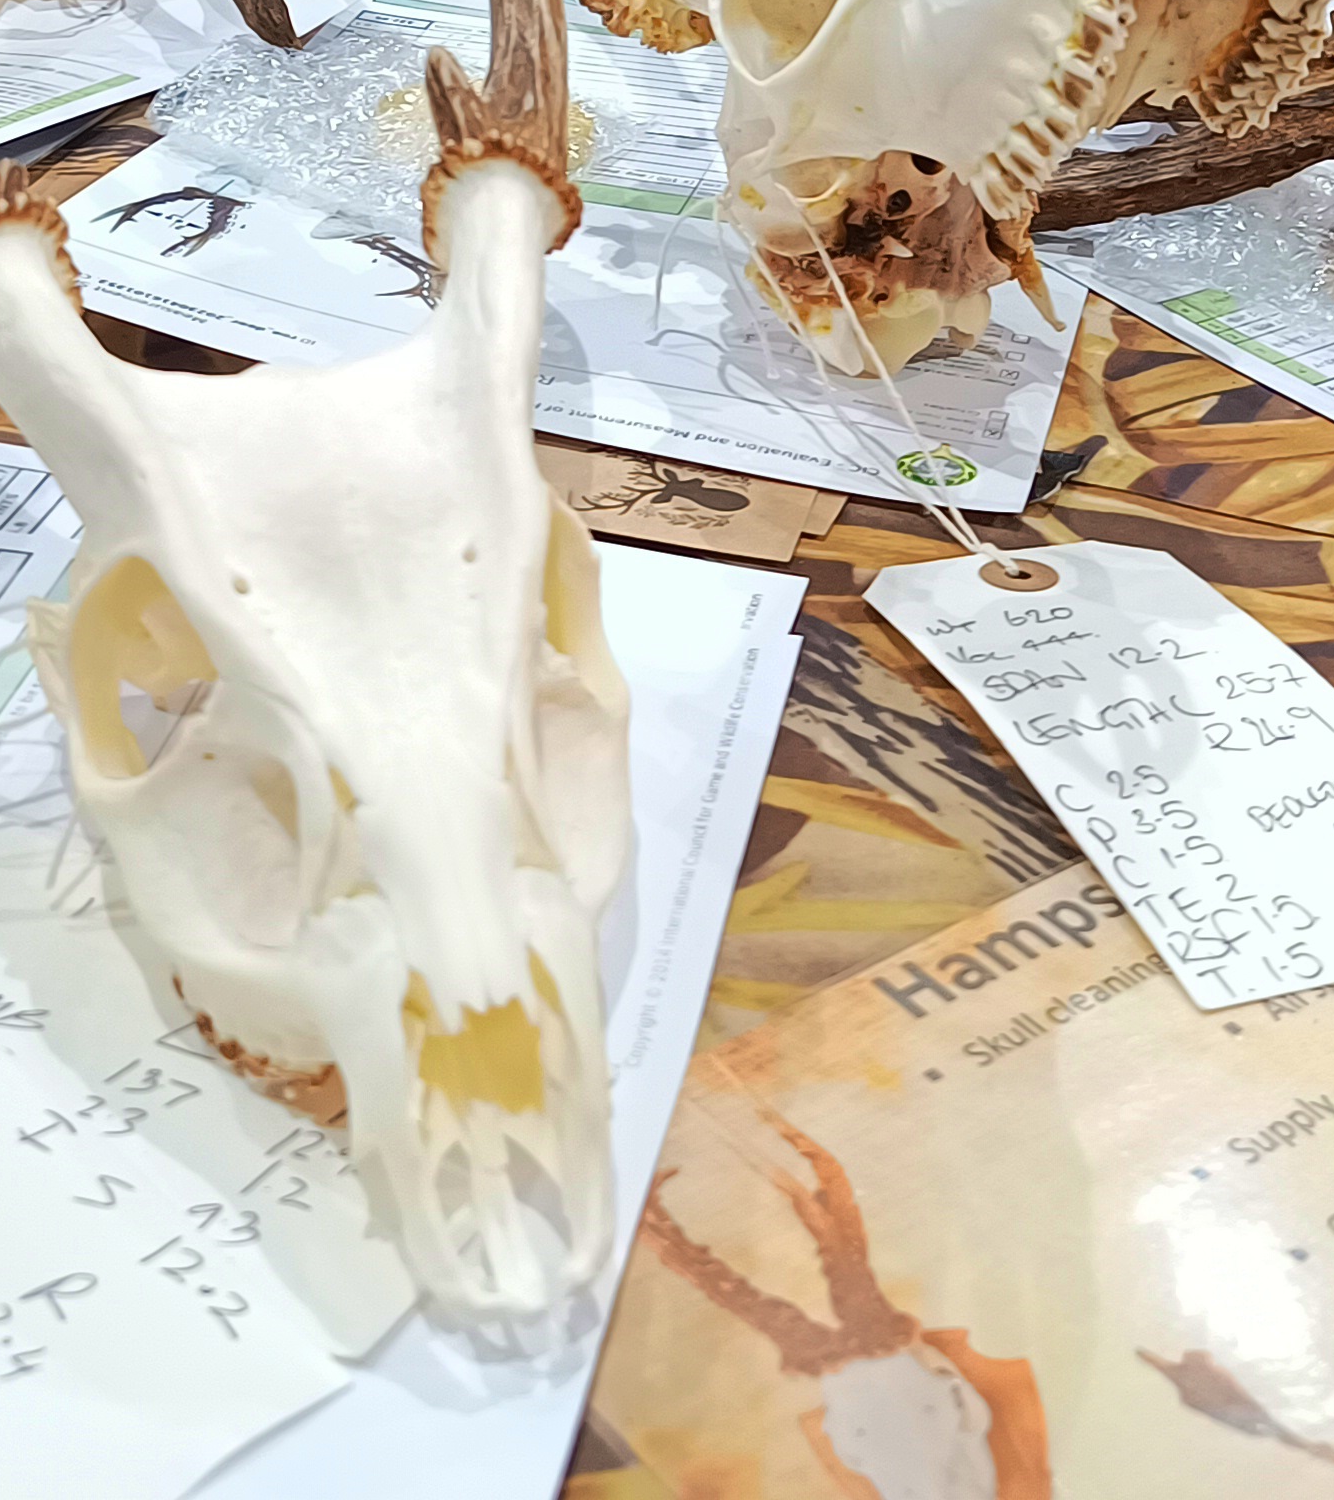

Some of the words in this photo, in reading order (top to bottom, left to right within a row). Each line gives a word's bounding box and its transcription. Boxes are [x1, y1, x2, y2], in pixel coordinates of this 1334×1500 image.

[542, 403, 565, 415] of
[568, 407, 690, 438] Measurement
[695, 431, 732, 447] and
[736, 440, 832, 470] Evaluation
[1004, 606, 1074, 628] 620
[727, 647, 760, 715] Conservation
[718, 713, 742, 750] Wildlife
[1203, 721, 1253, 752] R
[715, 749, 731, 772] and
[702, 771, 724, 808] Game
[1055, 784, 1095, 813] C
[697, 805, 713, 826] for
[682, 824, 709, 867] Council
[1112, 855, 1151, 889] C
[1216, 872, 1259, 904] 2
[662, 868, 696, 946] International
[962, 1013, 1045, 1068] Skull
[1046, 947, 1175, 1025] cleaning
[18, 1271, 99, 1323] R
